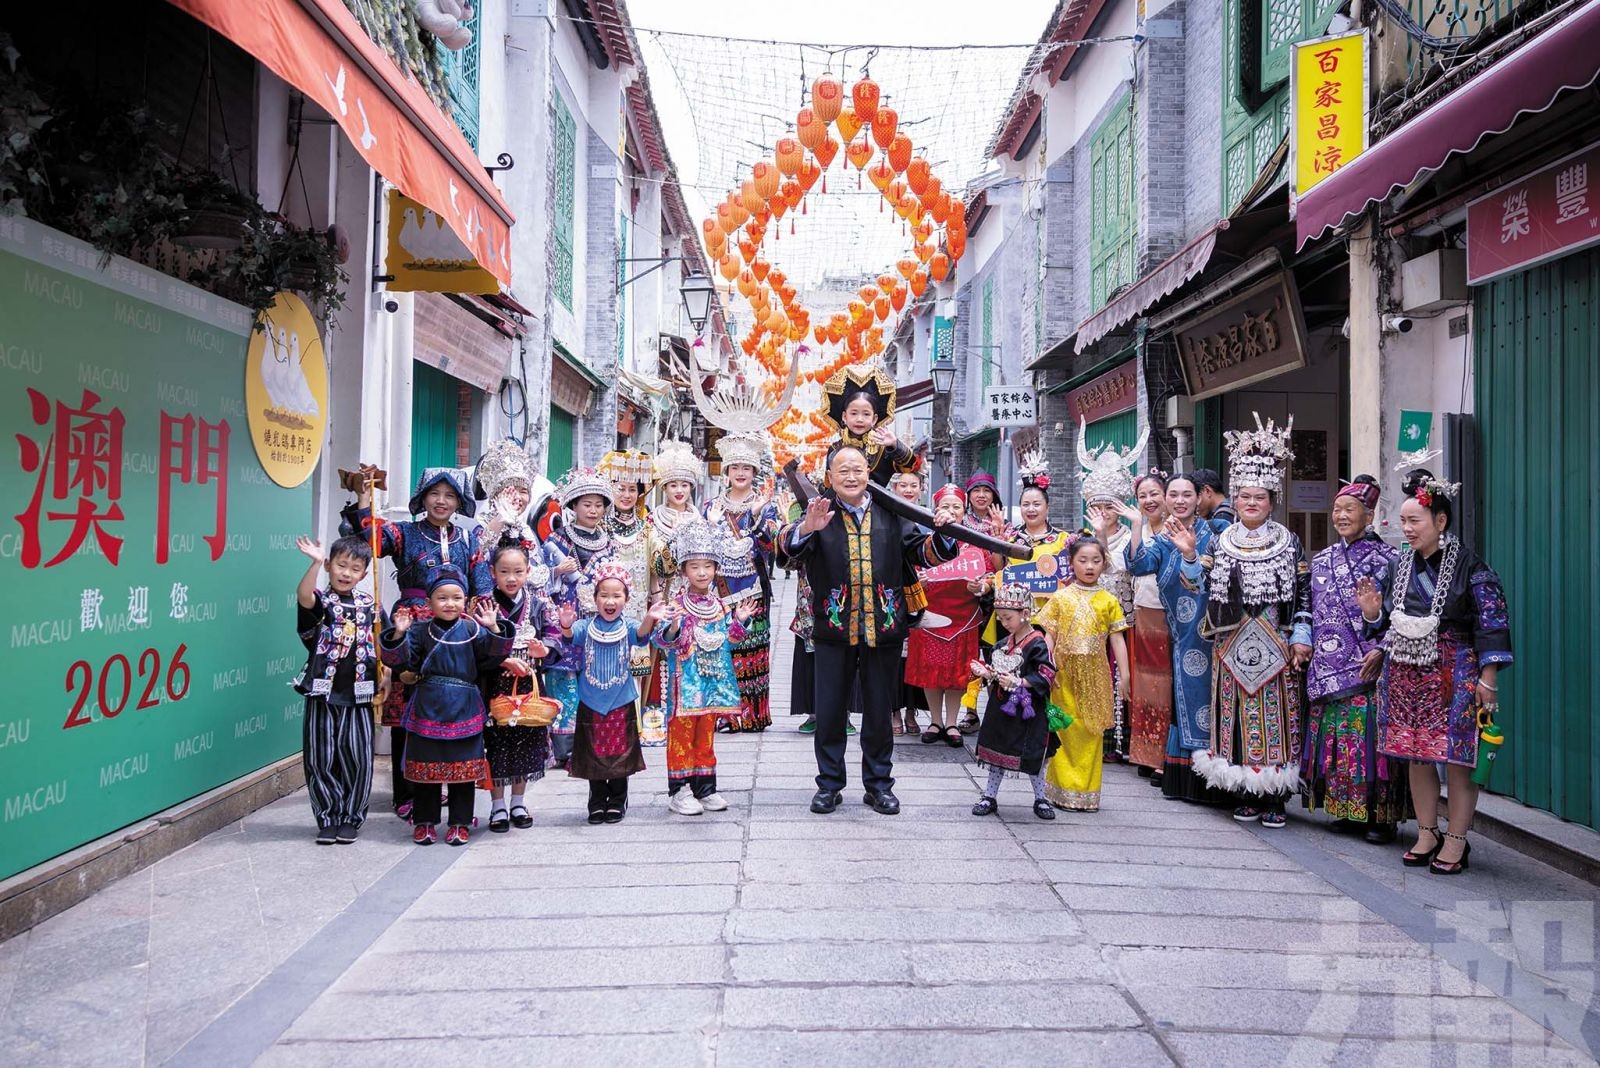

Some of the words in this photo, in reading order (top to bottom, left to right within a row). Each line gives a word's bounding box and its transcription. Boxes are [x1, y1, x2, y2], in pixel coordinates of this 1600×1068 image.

[1313, 47, 1344, 174] 百家昌涼
[24, 269, 83, 309] MACAU
[112, 300, 160, 334] MACAU
[185, 326, 224, 355] MACAU
[78, 361, 129, 393] MACAU
[157, 380, 199, 408] MACAU
[990, 392, 1032, 404] 百家綜合
[991, 408, 1032, 421] 醫療中心
[14, 386, 231, 569] 澳門
[79, 581, 189, 633] 歡迎您
[237, 595, 270, 616] MACAU
[10, 618, 72, 649] MACAU
[213, 665, 249, 692] MACAU
[266, 655, 296, 677] MACAU
[62, 642, 191, 730] 2026
[234, 713, 267, 739] MACAU
[174, 730, 214, 761] MACAU
[99, 752, 149, 789] MACAU
[4, 780, 67, 823] MACAU
